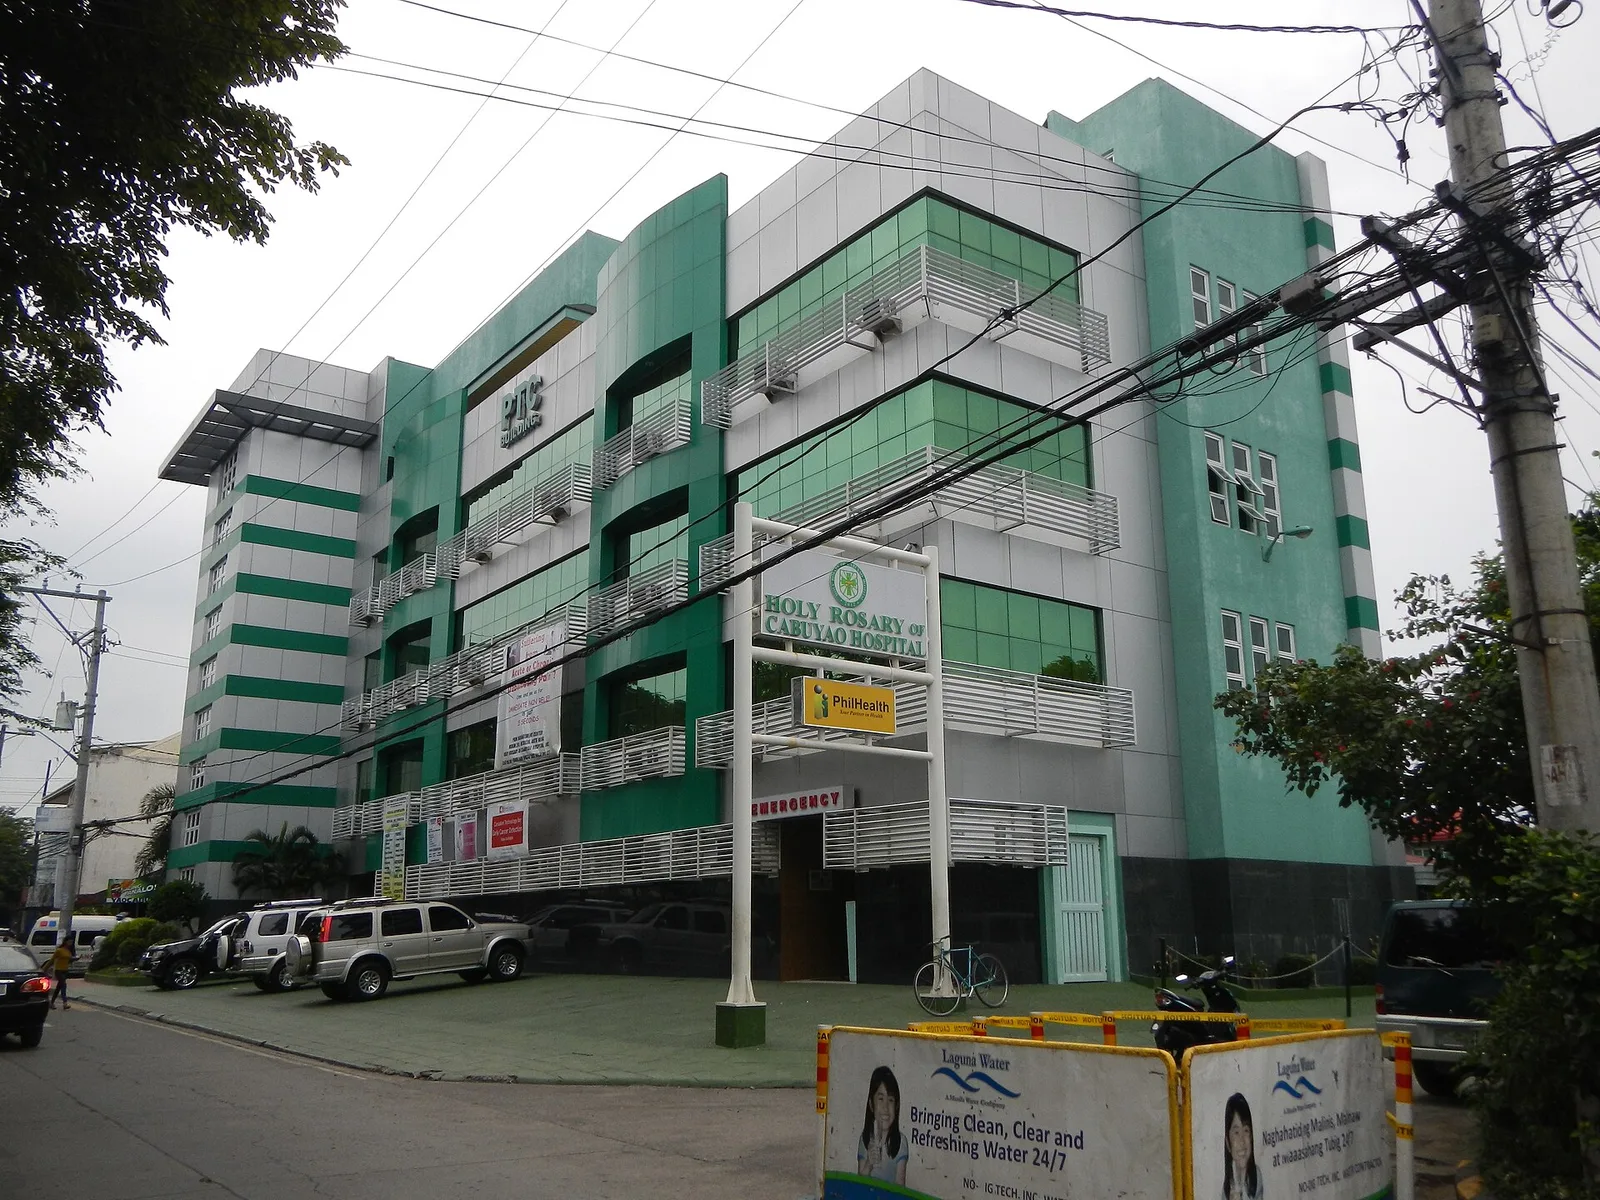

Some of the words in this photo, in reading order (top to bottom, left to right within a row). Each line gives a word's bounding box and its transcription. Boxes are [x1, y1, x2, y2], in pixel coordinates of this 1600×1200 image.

[501, 374, 543, 431] PTC
[501, 410, 542, 448] BUILDING
[764, 594, 821, 620] HOLY
[829, 604, 904, 634] ROSARY
[908, 623, 926, 637] OF
[765, 615, 847, 645] CABUYAO
[849, 629, 927, 658] HOSPITAL
[511, 666, 525, 678] Acute
[833, 695, 890, 713] PhilHealth
[752, 792, 840, 817] EMERGENCY
[941, 1048, 977, 1070] Laguna
[978, 1052, 1011, 1071] Water
[1276, 1061, 1300, 1080] Laguna
[910, 1106, 960, 1134] Bringing
[963, 1114, 1009, 1140] Clean,
[1013, 1121, 1051, 1144] Clear
[1054, 1130, 1085, 1151] and
[911, 1127, 979, 1160] Refreshing
[983, 1139, 1029, 1164] Water
[1032, 1147, 1067, 1173] 24/7
[1272, 1152, 1281, 1168] at
[994, 1184, 1021, 1200] TECH.
